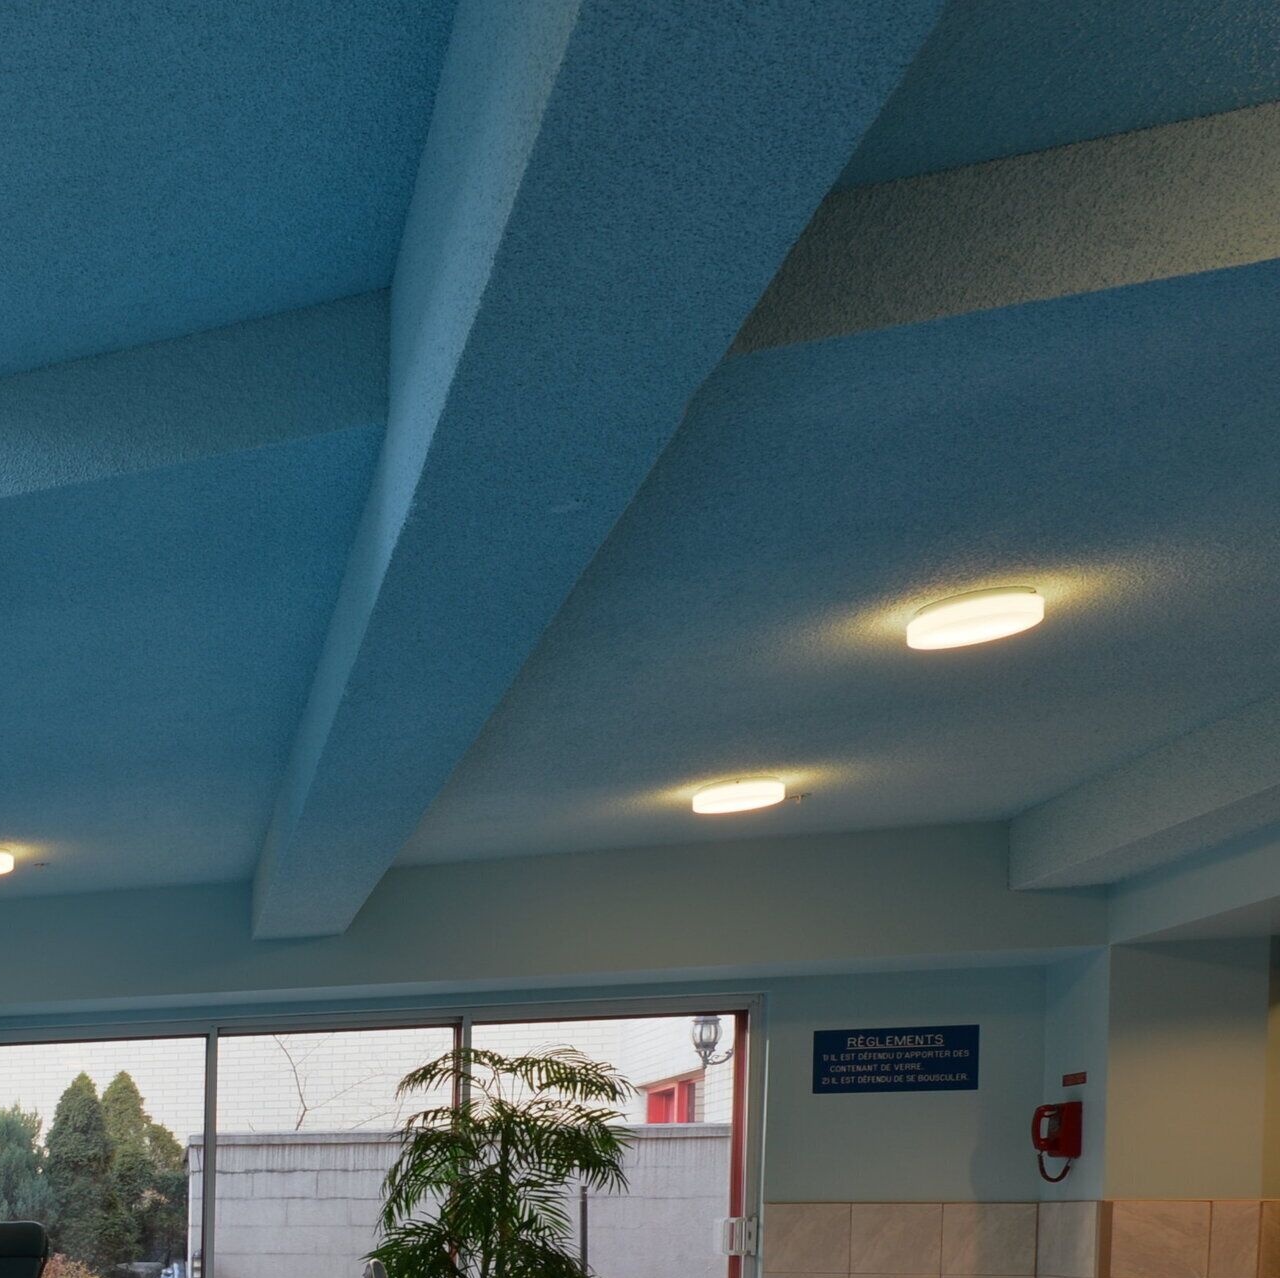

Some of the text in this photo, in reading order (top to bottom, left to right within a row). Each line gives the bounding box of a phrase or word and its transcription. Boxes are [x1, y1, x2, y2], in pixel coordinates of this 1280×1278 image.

[847, 1033, 944, 1048] RÈGLEMENTS
[841, 1053, 856, 1061] EST
[858, 1051, 894, 1060] DÉFENDU
[953, 1049, 970, 1057] DES
[829, 1064, 878, 1073] CONTENANT
[880, 1063, 892, 1072] DE
[841, 1076, 856, 1084] EST
[858, 1074, 892, 1083] DÉFENDU
[893, 1074, 904, 1082] DE
